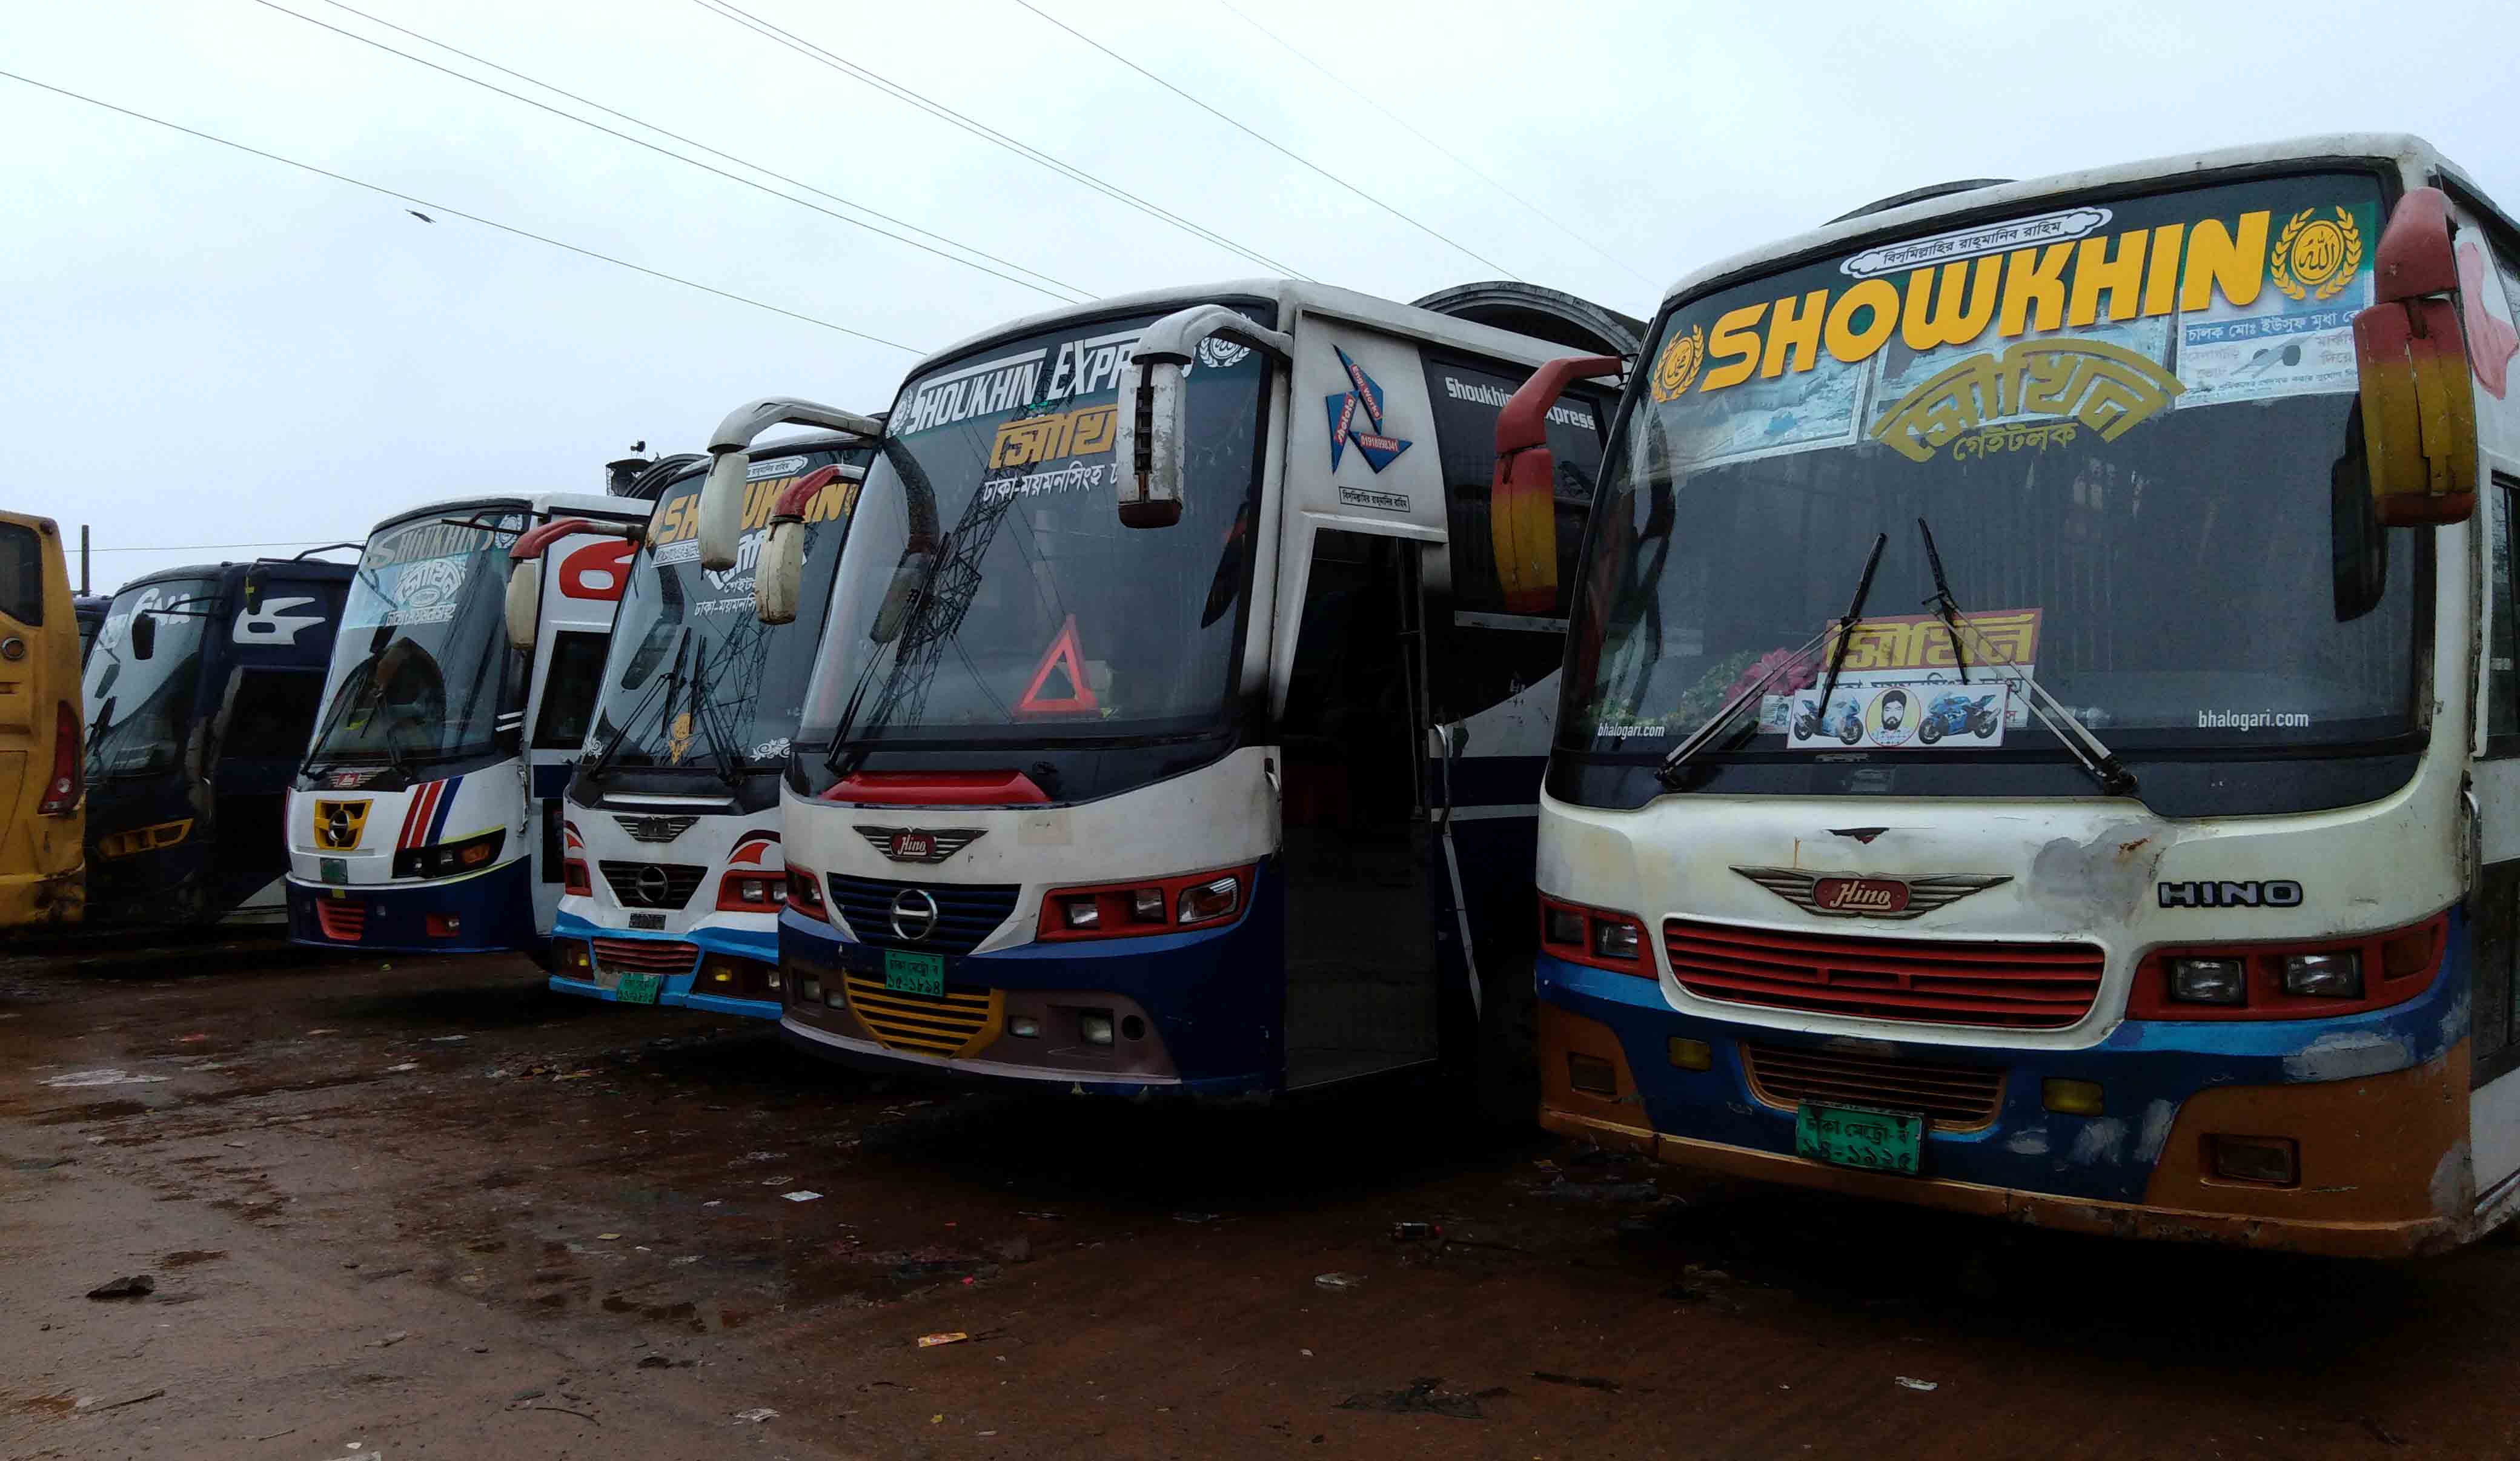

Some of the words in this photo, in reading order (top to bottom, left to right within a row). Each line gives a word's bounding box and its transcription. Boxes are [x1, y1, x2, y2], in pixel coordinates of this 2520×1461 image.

[1699, 210, 2270, 393] SHOWKHIN
[904, 348, 1048, 436] SHOUKHIN
[1597, 723, 1665, 740] bhalogari.com
[2198, 709, 2309, 732] bhalogari.com
[897, 833, 927, 855] Hino
[1829, 880, 1891, 909] Hino
[2158, 880, 2304, 907] HINO
